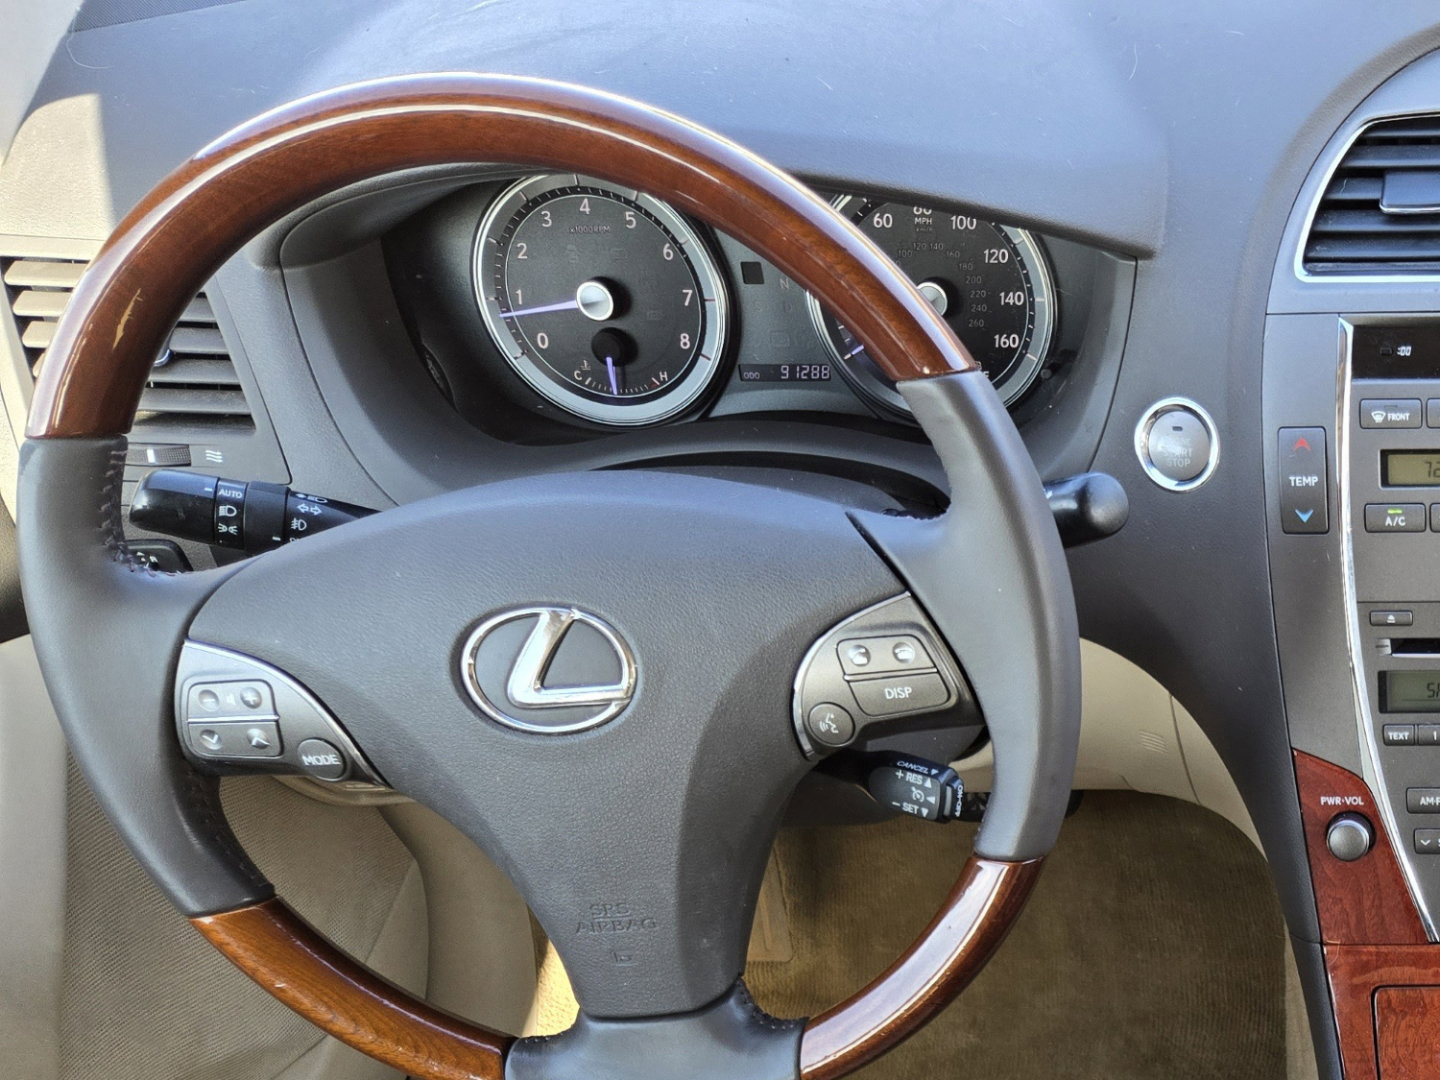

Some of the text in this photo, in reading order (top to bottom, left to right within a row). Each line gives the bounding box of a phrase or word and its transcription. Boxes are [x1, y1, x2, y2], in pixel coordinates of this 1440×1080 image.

[579, 198, 590, 214] 4
[541, 211, 552, 227] 3
[625, 211, 636, 229] 5
[873, 213, 893, 228] 60
[914, 217, 933, 225] MPH
[950, 215, 977, 230] 100
[517, 243, 528, 259] 2
[663, 243, 674, 261] 6
[983, 249, 1009, 263] 120
[966, 276, 981, 284] 200
[515, 289, 523, 305] 1
[682, 290, 693, 306] 7
[970, 290, 986, 298] 220
[999, 292, 1024, 305] 140
[971, 304, 987, 312] 240
[968, 319, 985, 327] 260
[537, 332, 549, 350] 0
[680, 333, 690, 350] 8
[994, 334, 1019, 348] 160
[574, 371, 582, 381] C
[659, 371, 669, 382] H
[743, 365, 830, 379] ODO 91288
[1387, 412, 1410, 421] FRONT
[1289, 476, 1319, 487] TEMP
[218, 488, 243, 499] AUTO
[1385, 516, 1406, 527] A/C
[884, 687, 913, 700] DISP
[1388, 731, 1410, 740] TEXT
[302, 753, 341, 767] MODE
[896, 760, 929, 774] CANCEL
[905, 772, 923, 785] RES
[902, 802, 920, 815] SET
